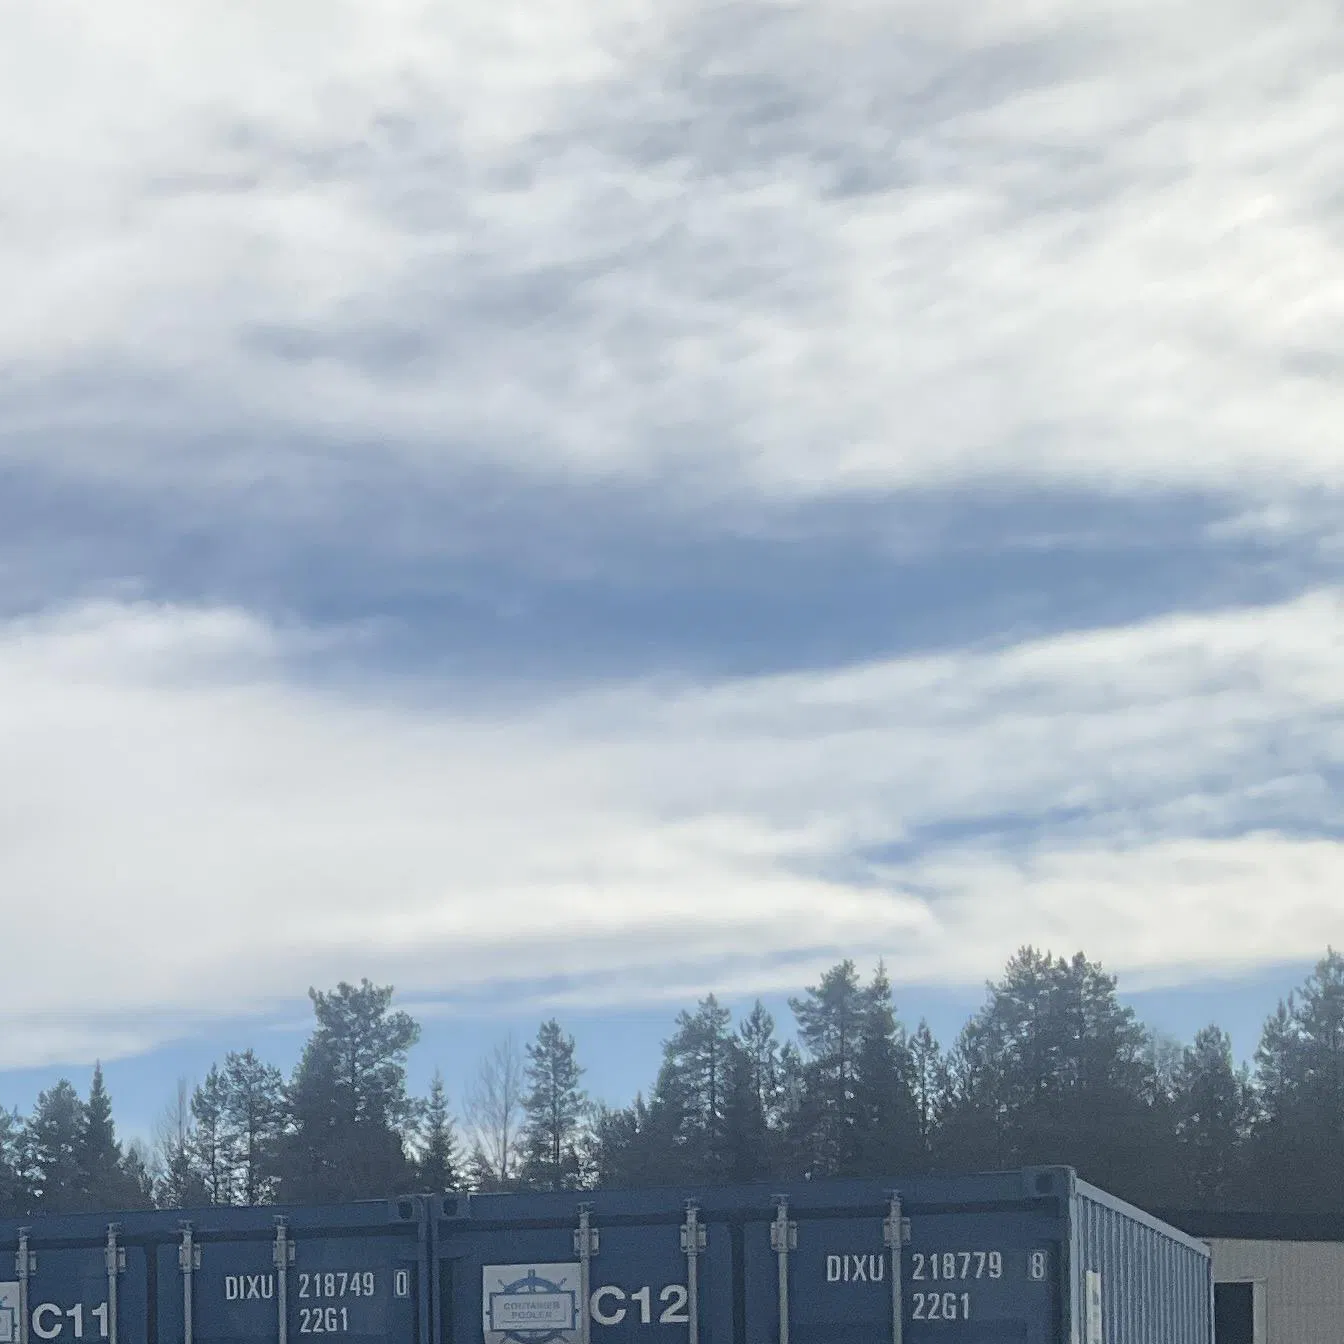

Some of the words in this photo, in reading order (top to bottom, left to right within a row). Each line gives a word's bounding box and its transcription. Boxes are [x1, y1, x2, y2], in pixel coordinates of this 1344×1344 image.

[826, 1254, 884, 1282] DIXU
[912, 1252, 1003, 1280] 218779
[1031, 1252, 1045, 1279] 8
[225, 1275, 273, 1300] DIXU
[299, 1272, 375, 1297] 218749
[590, 1284, 689, 1325] C12
[912, 1293, 969, 1320] 22G1
[32, 1302, 108, 1339] C11
[300, 1308, 348, 1333] 22G1
